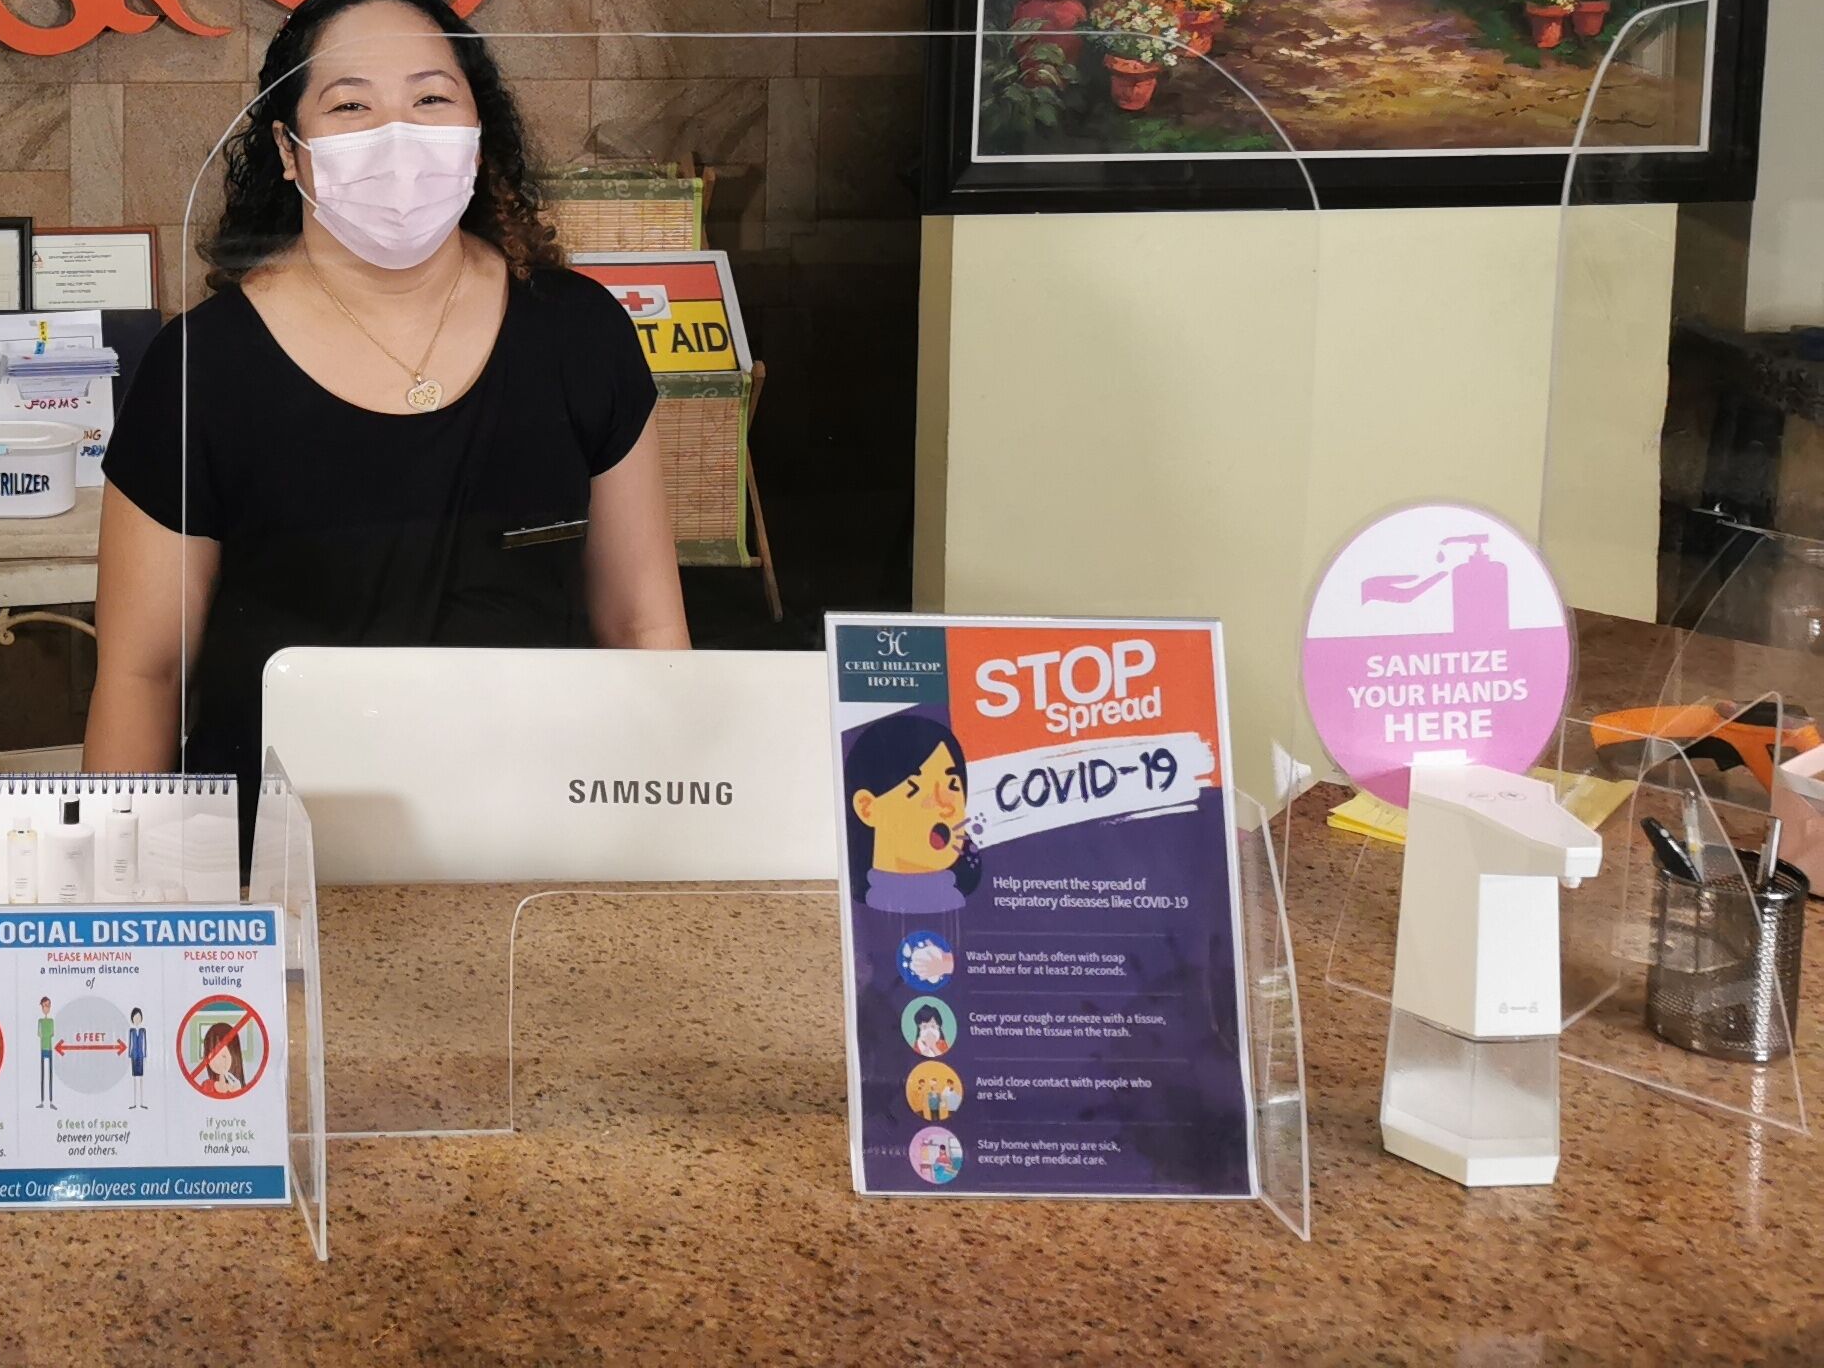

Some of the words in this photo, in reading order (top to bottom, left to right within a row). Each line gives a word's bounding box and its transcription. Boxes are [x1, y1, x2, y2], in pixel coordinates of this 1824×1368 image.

[671, 322, 729, 354] AID
[24, 398, 80, 410] FORMS
[844, 660, 876, 671] CEBU
[879, 661, 941, 672] HILLTOP
[1366, 650, 1508, 678] SANITIZE
[867, 676, 920, 687] HOTEL
[975, 639, 1157, 718] STOP
[1347, 685, 1425, 709] YOUR
[1432, 678, 1528, 705] HANDS
[1045, 686, 1162, 736] Spread
[1384, 709, 1493, 743] HERE
[995, 747, 1178, 812] COVID-19
[568, 779, 733, 806] SAMSUNG
[992, 876, 1022, 892] Help
[1022, 878, 1069, 892] prevent
[1069, 877, 1090, 891] the
[1091, 878, 1133, 893] spread
[1133, 877, 1147, 891] of
[993, 895, 1058, 911] respiratory
[1059, 894, 1110, 909] diseases
[1111, 895, 1133, 909] like
[1133, 895, 1189, 909] COVID-19
[92, 918, 268, 944] DISTANCING
[47, 951, 82, 963] PLEASE
[82, 951, 132, 962] MAINTAIN
[183, 950, 220, 961] PLEASE
[219, 950, 236, 961] DO
[236, 950, 259, 961] NOT
[965, 950, 994, 962] Wash
[994, 952, 1017, 964] your
[1018, 950, 1049, 963] hands
[1049, 951, 1077, 963] often
[1077, 951, 1100, 963] with
[1101, 953, 1126, 965] soap
[39, 966, 46, 975] a
[48, 964, 96, 975] minimum
[97, 964, 140, 975] distance
[198, 964, 226, 974] enter
[227, 965, 245, 974] our
[84, 976, 96, 990] of
[202, 975, 243, 989] building
[75, 1032, 82, 1043] 6
[82, 1031, 107, 1043] FEET
[975, 1075, 1004, 1088] Avoid
[1004, 1076, 1031, 1088] close
[1031, 1077, 1070, 1089] contact
[1070, 1076, 1093, 1089] with
[1094, 1076, 1129, 1091] people
[1129, 1076, 1153, 1089] who
[25, 1180, 53, 1197] Our
[139, 1178, 170, 1196] and
[174, 1178, 253, 1196] Customers
